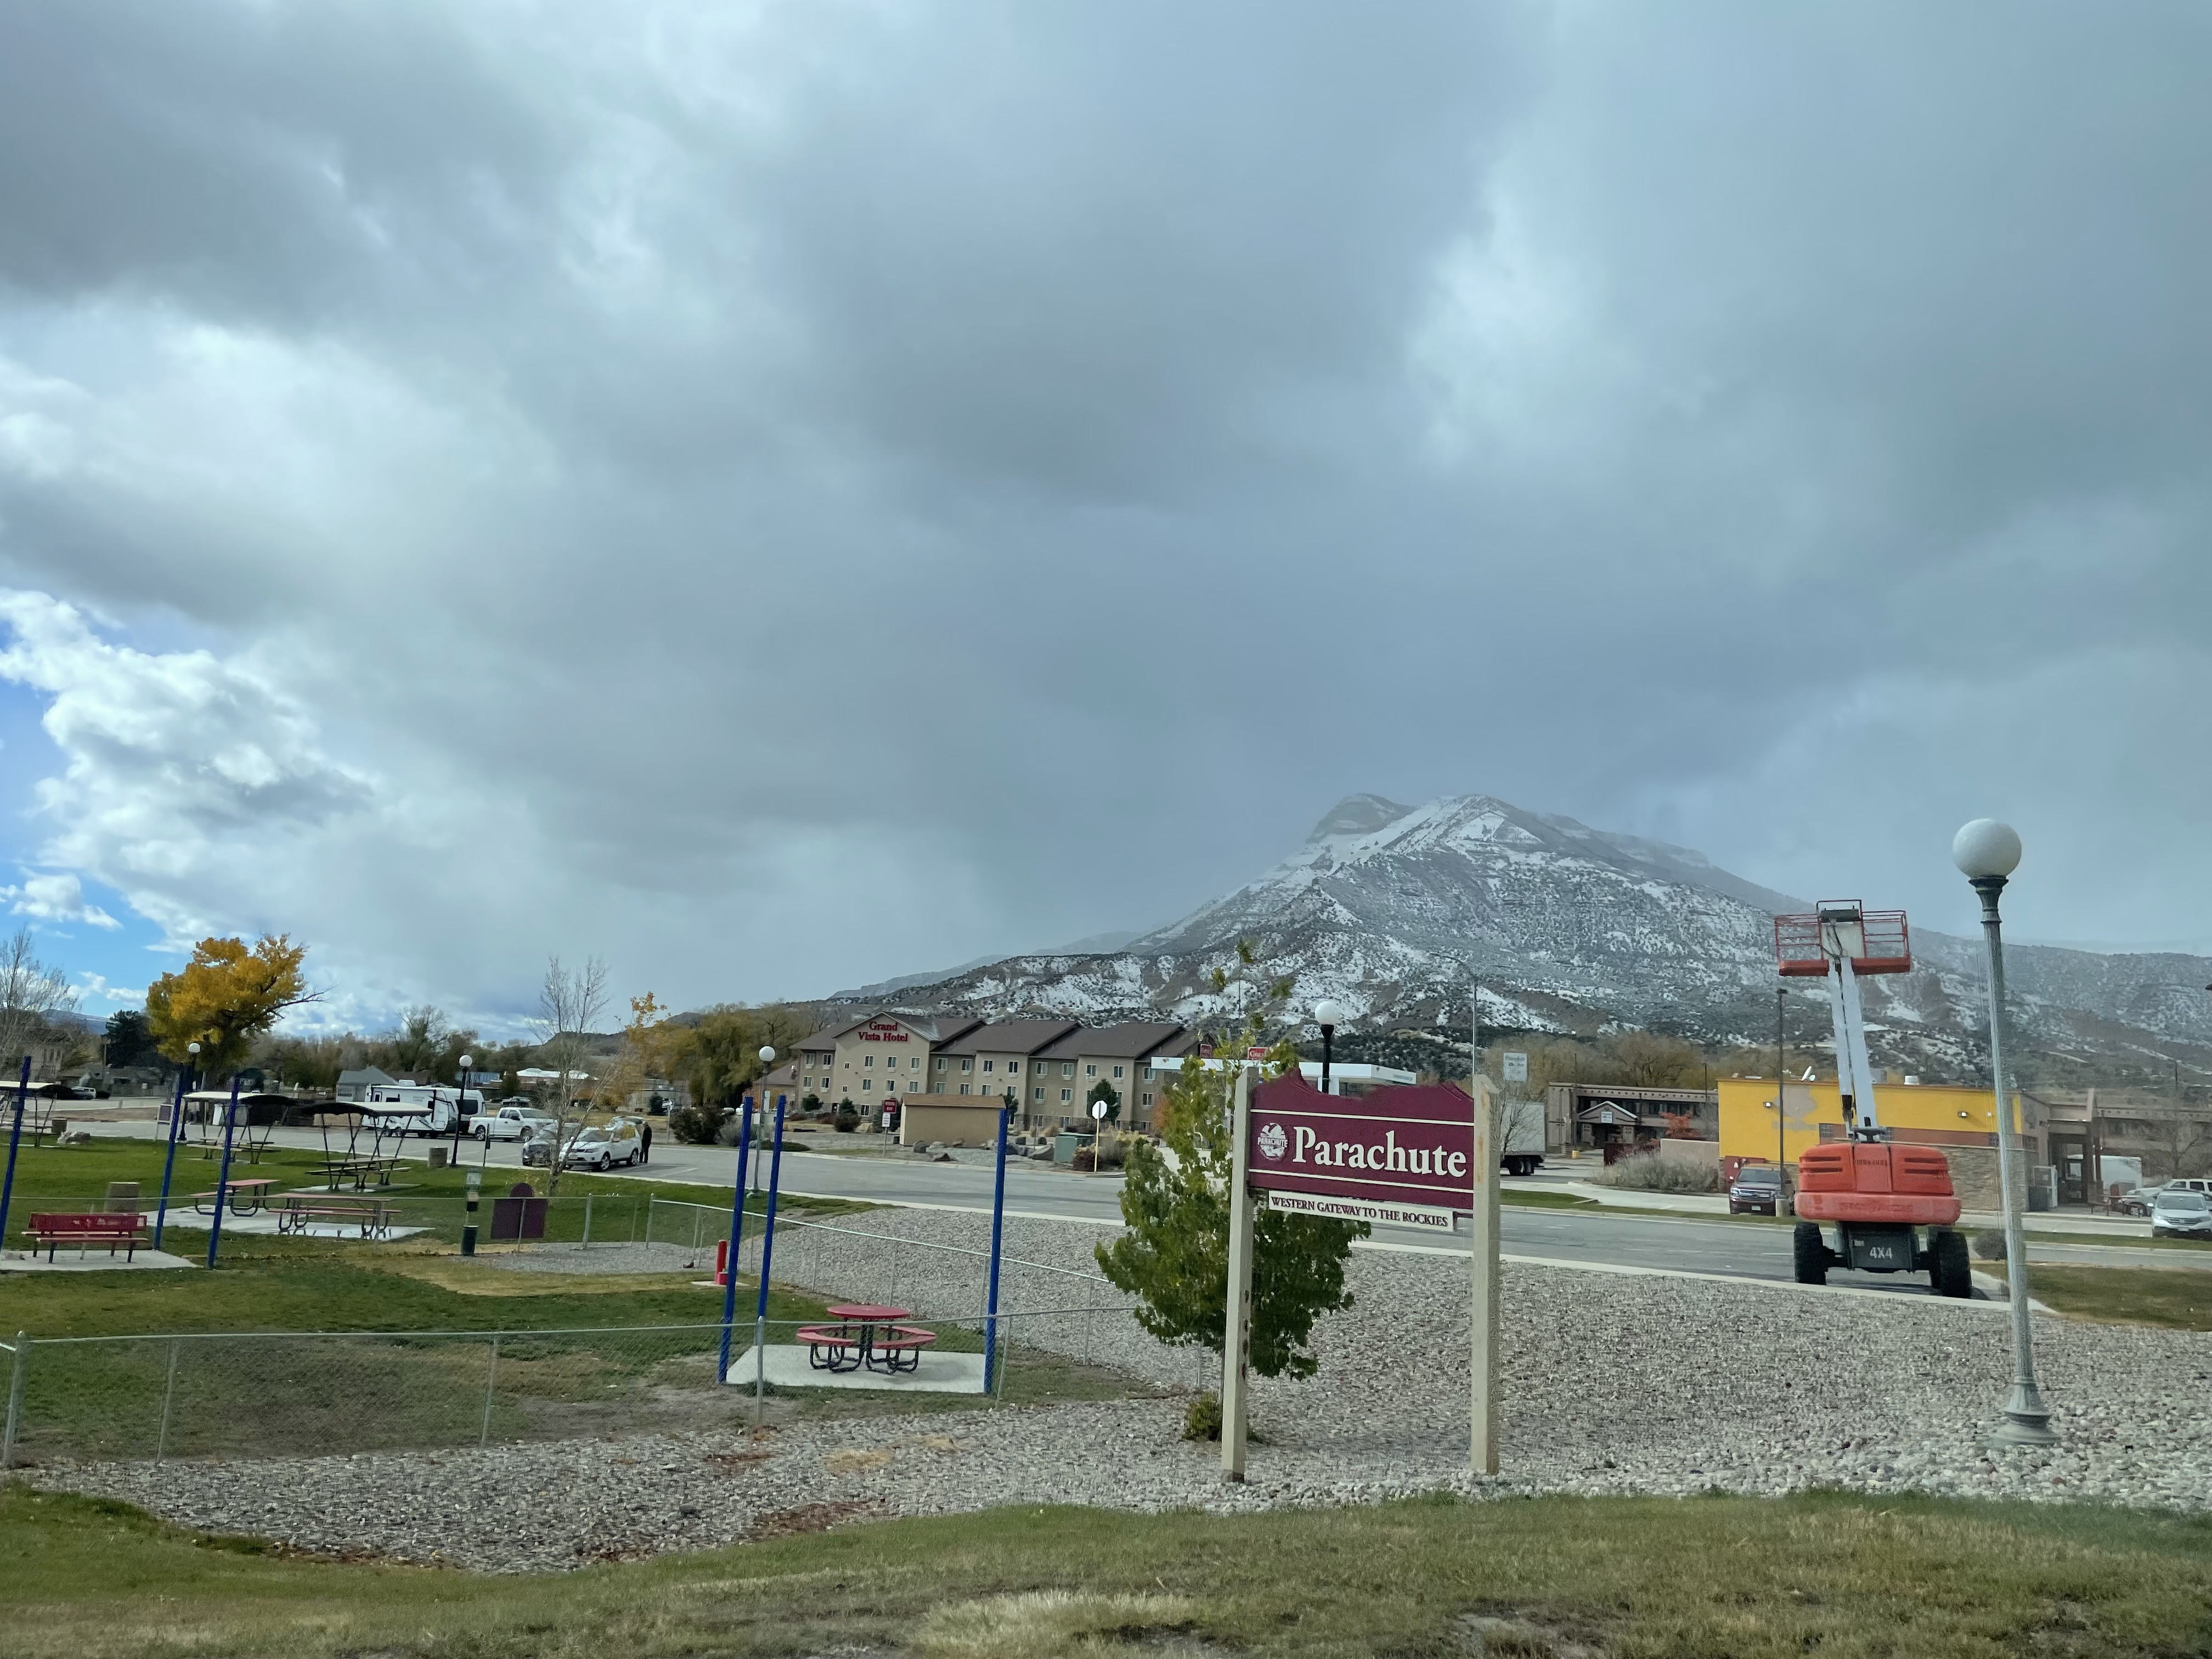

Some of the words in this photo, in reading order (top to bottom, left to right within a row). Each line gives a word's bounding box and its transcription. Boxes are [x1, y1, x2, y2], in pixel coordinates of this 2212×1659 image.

[868, 1021, 898, 1031] Grand
[858, 1031, 881, 1041] Vista
[883, 1032, 909, 1042] Hotel
[1257, 1137, 1288, 1148] PARACHUTE
[1292, 1126, 1466, 1177] Parachute
[1271, 1197, 1316, 1211] WESTERN
[1317, 1202, 1362, 1216] GATEWAY
[1362, 1207, 1377, 1218] TO
[1378, 1209, 1401, 1221] THE
[1402, 1211, 1448, 1227] ROCKIES
[1869, 1246, 1893, 1260] 4X4
